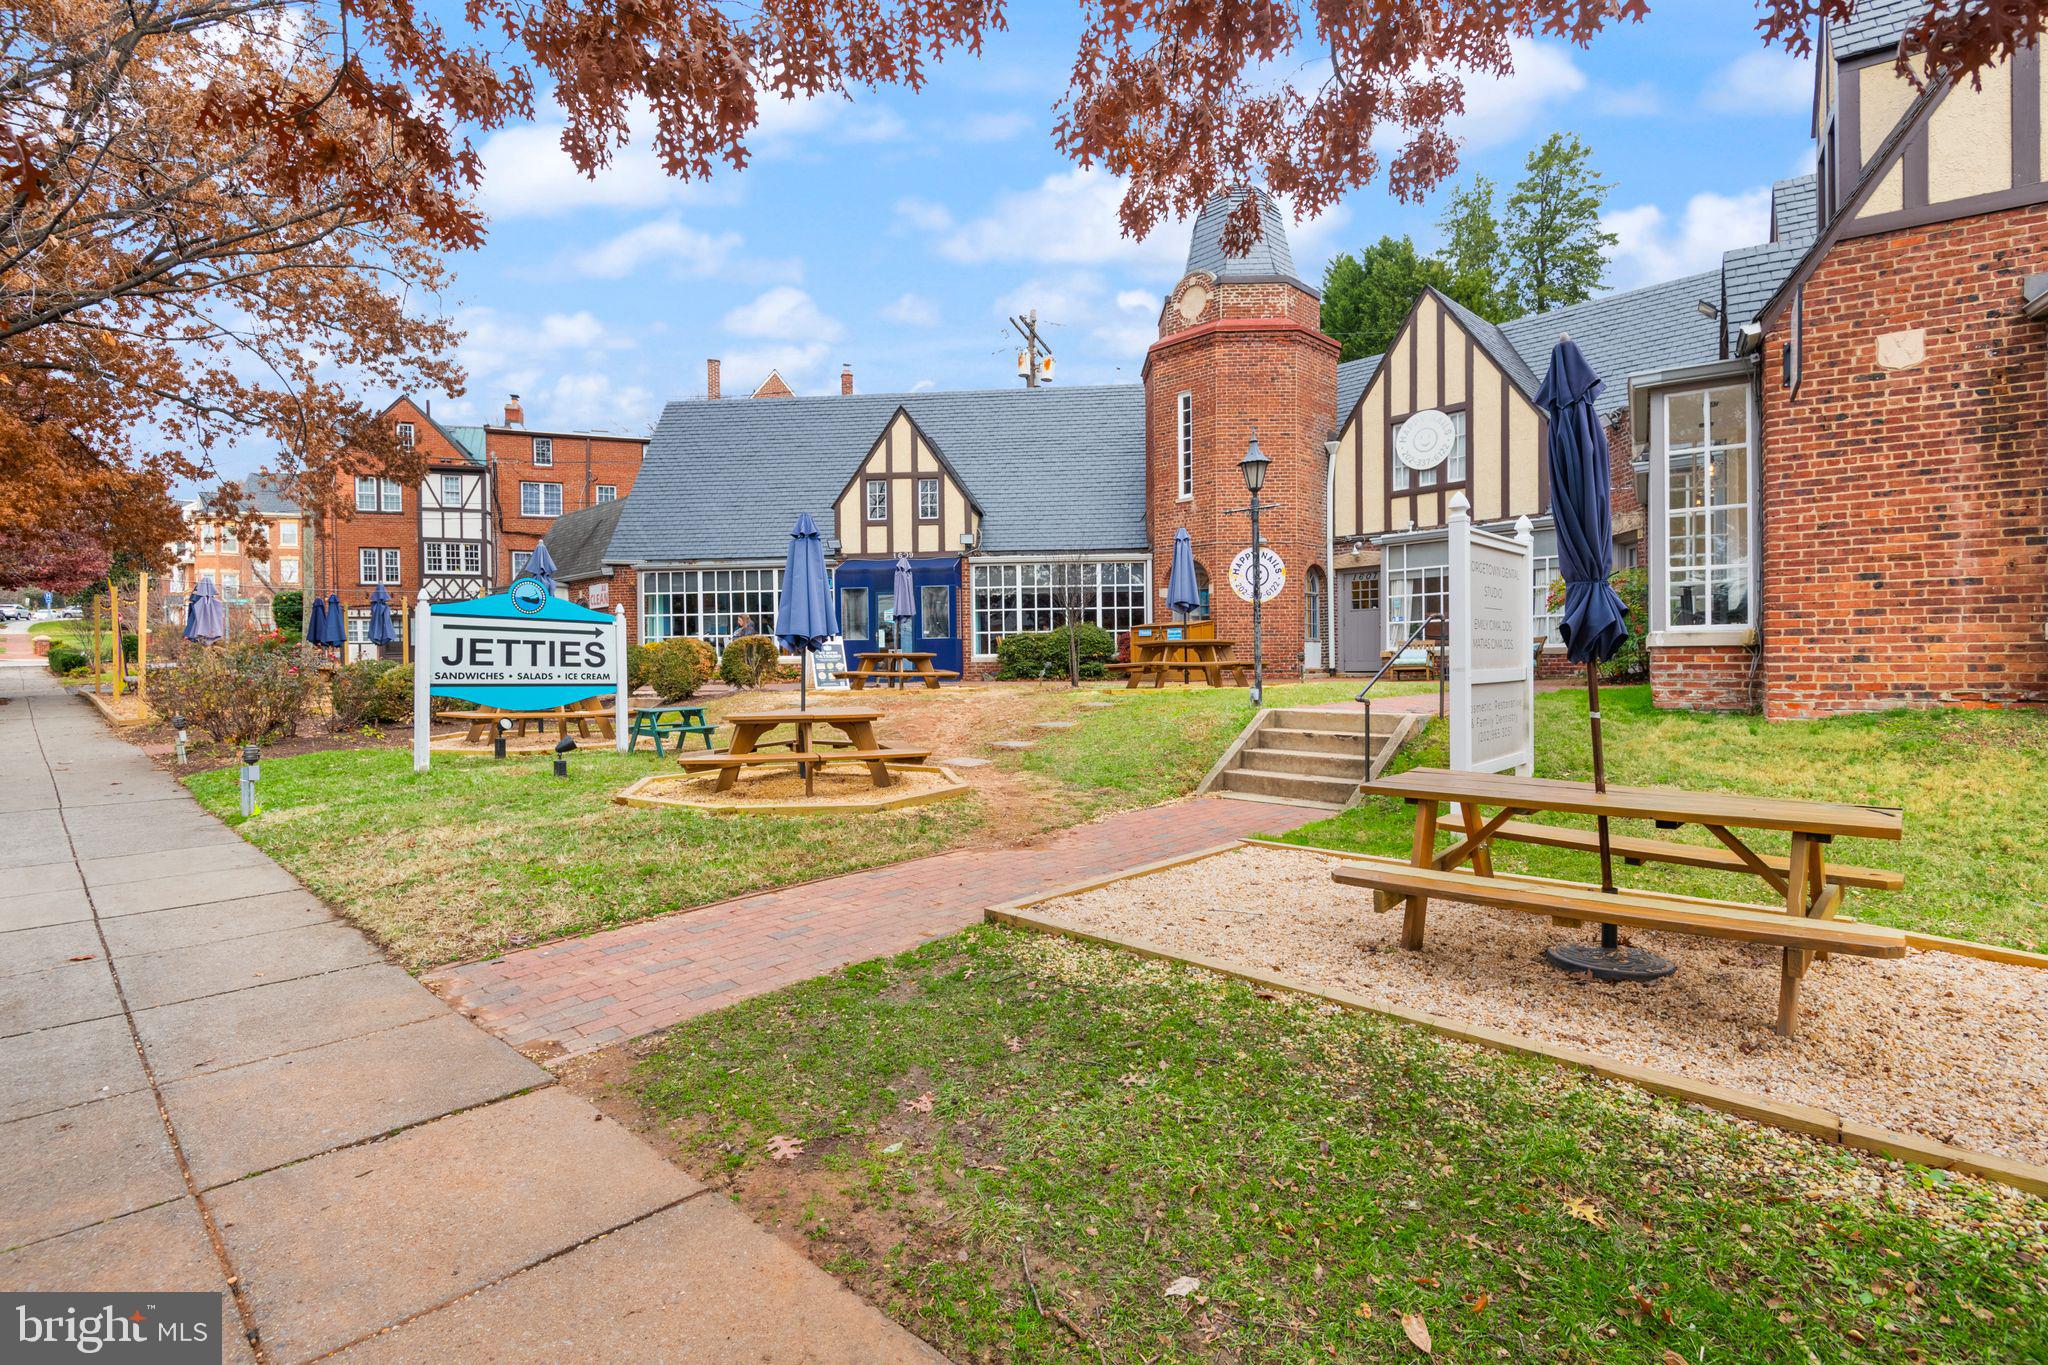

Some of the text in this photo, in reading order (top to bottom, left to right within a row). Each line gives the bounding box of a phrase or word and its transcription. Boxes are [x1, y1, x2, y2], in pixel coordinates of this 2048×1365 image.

[1261, 552, 1282, 574] NAILS
[1352, 571, 1378, 580] 1607
[1501, 566, 1520, 580] DENTAL
[1484, 585, 1503, 599] STUDIO
[442, 637, 606, 668] JETTIES
[434, 671, 504, 680] SANDWICHES
[517, 672, 553, 680] SALADS
